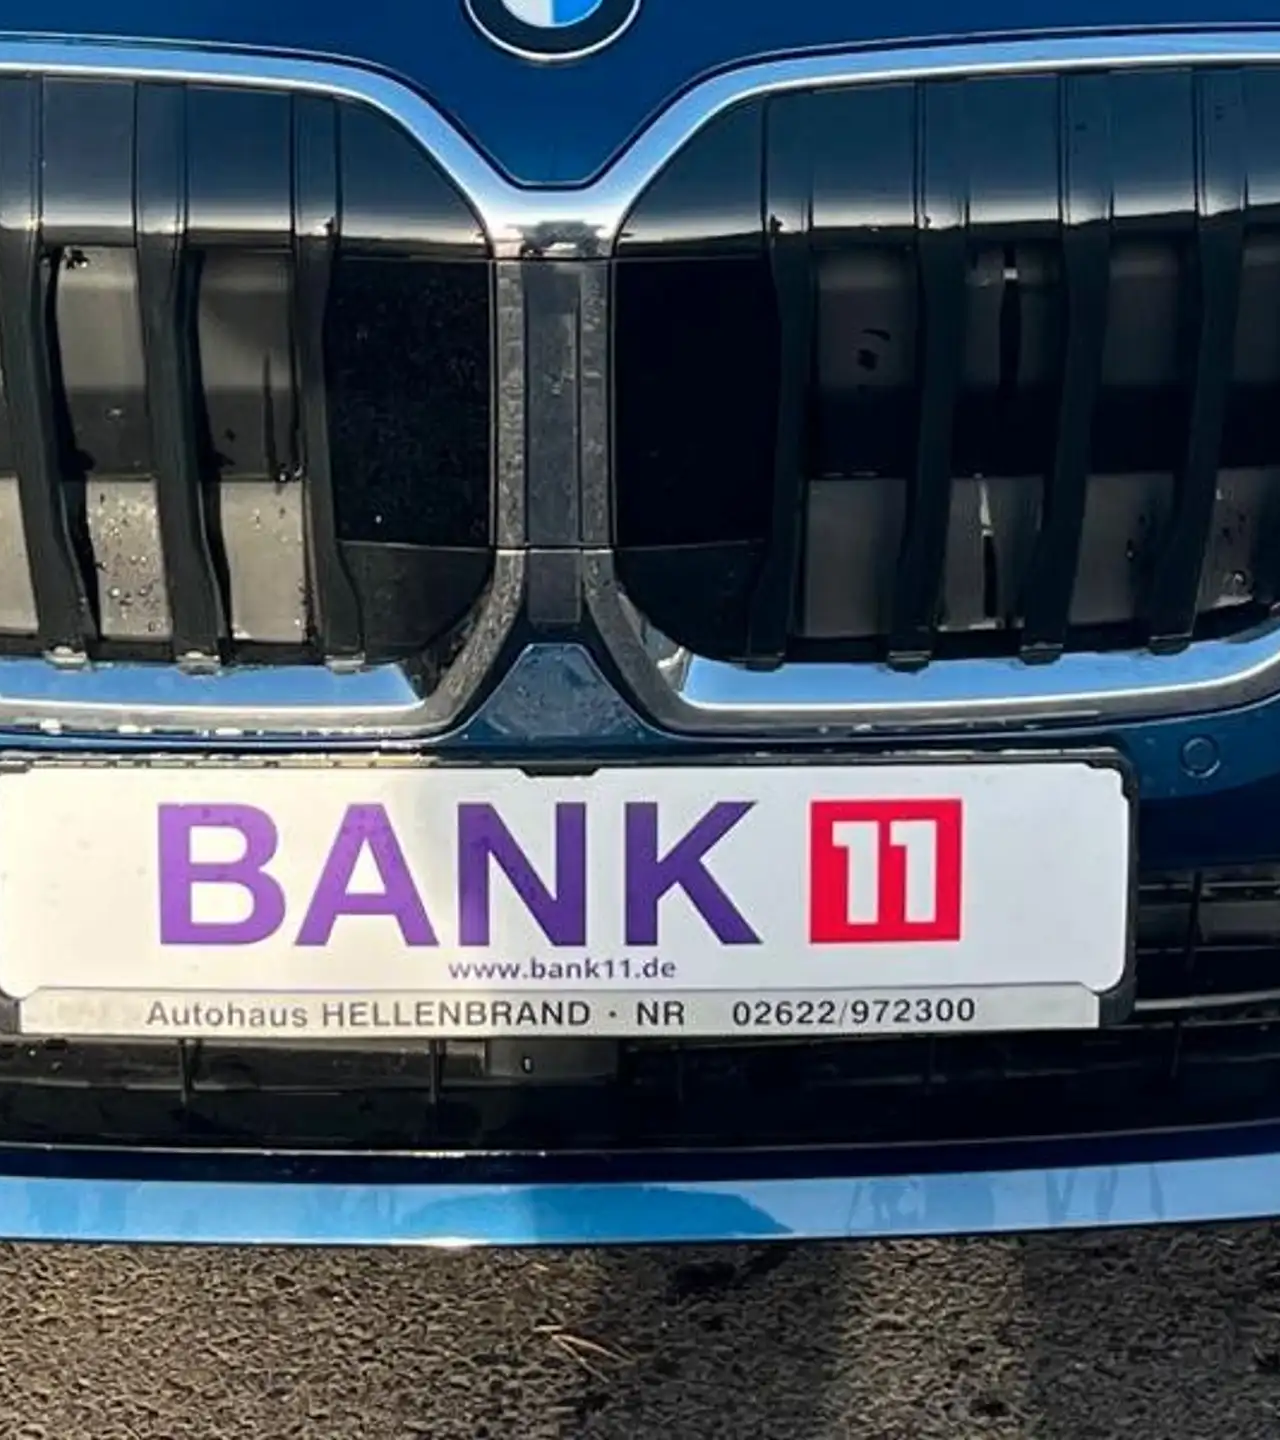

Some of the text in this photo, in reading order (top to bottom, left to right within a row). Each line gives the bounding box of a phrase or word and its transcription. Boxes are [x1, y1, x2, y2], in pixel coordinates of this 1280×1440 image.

[157, 801, 937, 946] BANK 11
[448, 959, 677, 981] www.bank11.de
[146, 997, 976, 1028] Autohaus HELLENBRAND NR 02622/972300
